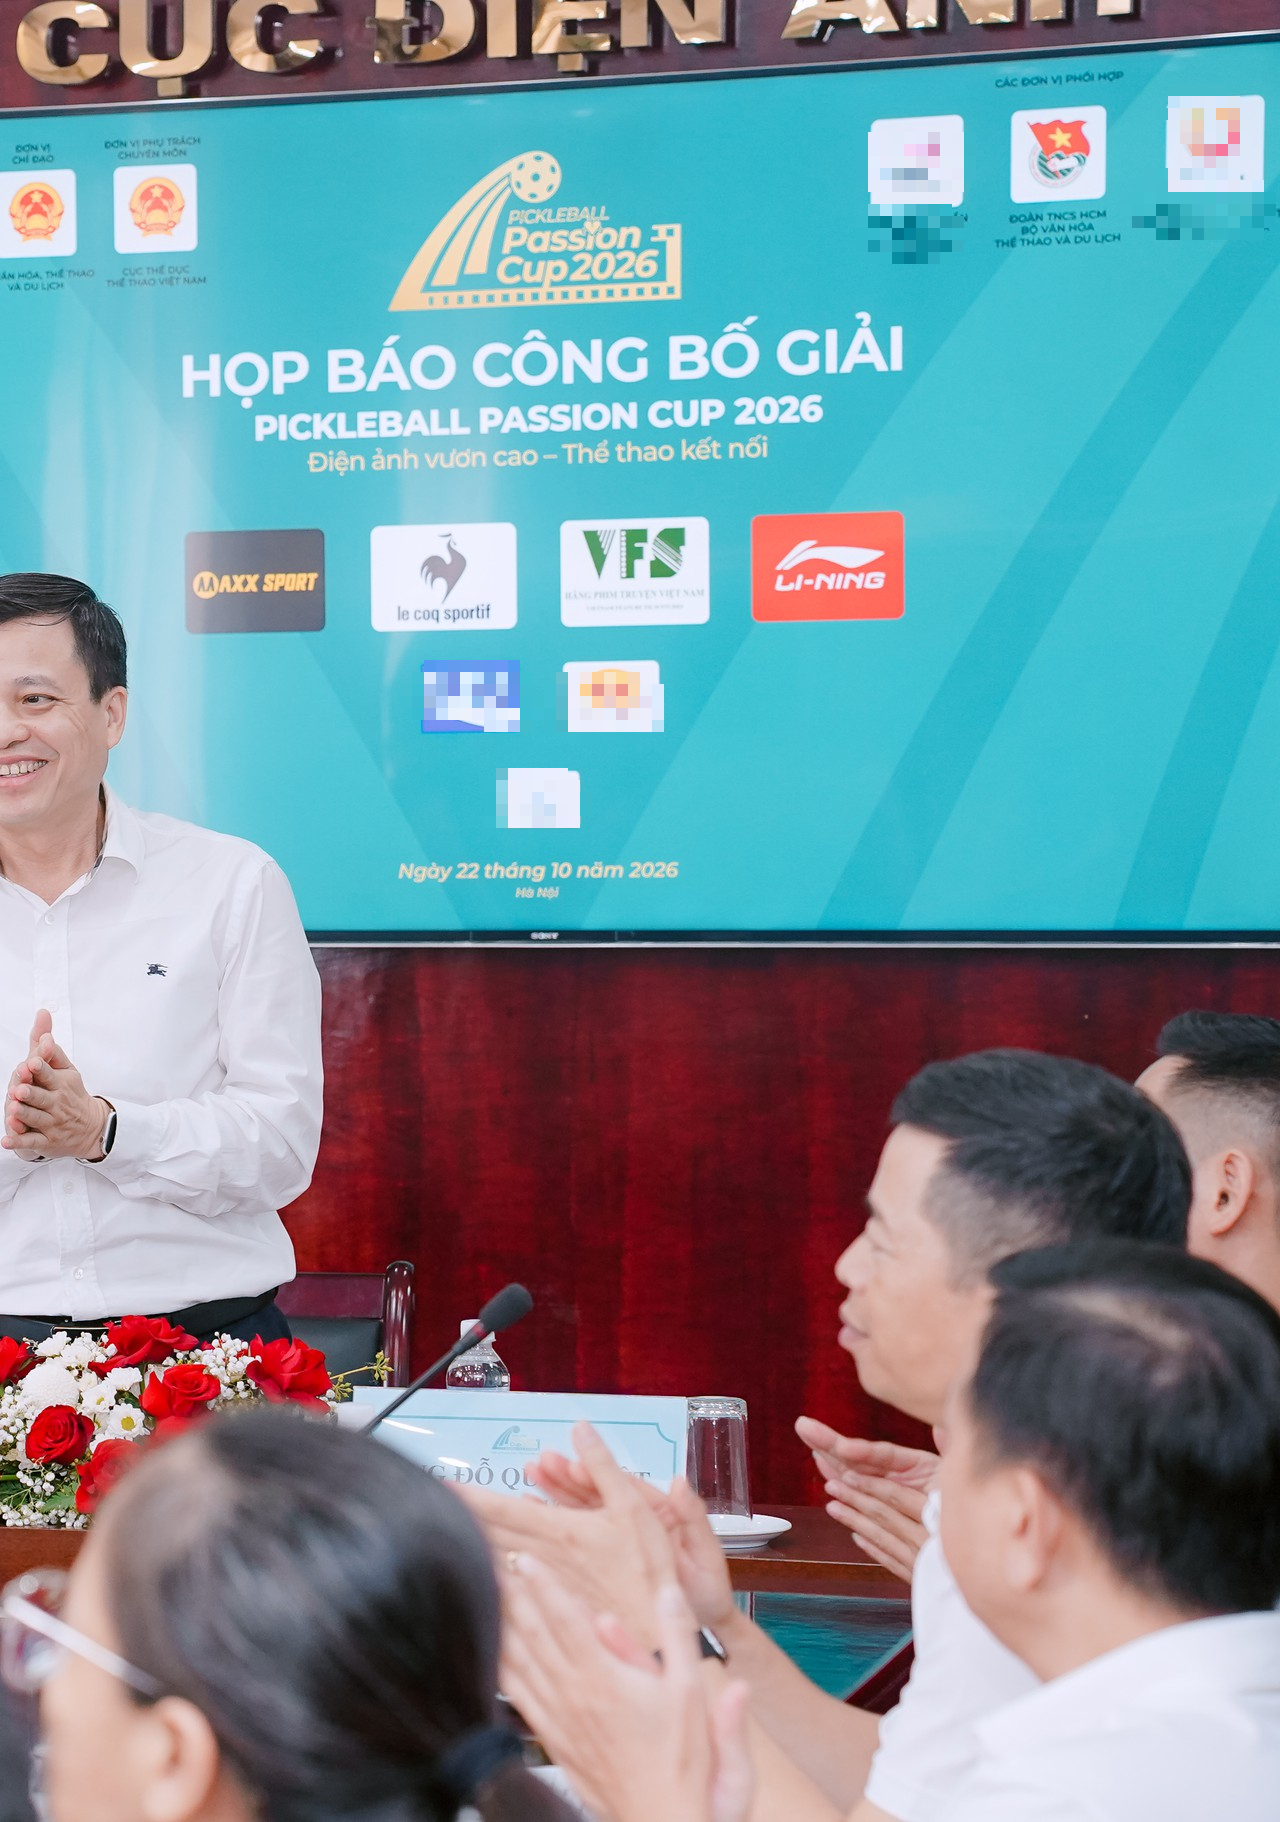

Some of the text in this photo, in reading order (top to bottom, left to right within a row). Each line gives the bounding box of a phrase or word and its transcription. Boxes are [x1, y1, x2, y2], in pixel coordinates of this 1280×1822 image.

[995, 70, 1124, 88] CÁC ĐƠN VỊ PHỐI HỢP
[104, 139, 127, 149] ĐƠN
[508, 205, 610, 225] PICKLEBALL
[1009, 210, 1107, 223] ĐOÀN TNCS HCM
[1021, 224, 1038, 235] BỘ
[1041, 223, 1065, 233] VĂN
[501, 224, 642, 255] Passion
[1020, 237, 1052, 246] THAO
[1055, 234, 1071, 244] VÀ
[1074, 235, 1091, 244] DU
[1095, 233, 1121, 244] LỊCH
[496, 249, 660, 289] Cup 2026
[24, 282, 39, 291] DU
[183, 276, 207, 285] NAM
[182, 311, 904, 409] HỌP BÁO CÔNG BỐ GIẢI
[254, 394, 824, 442] PICKLEBALL PASSION CUP 2026
[307, 450, 365, 476] Điện
[371, 447, 419, 471] ảnh
[424, 448, 486, 470] vươn
[493, 449, 539, 467] cao
[562, 439, 610, 465] Thể
[615, 440, 675, 463] thao
[681, 436, 722, 461] kết
[728, 434, 769, 459] nối
[582, 527, 686, 580] VFS
[262, 572, 319, 592] SPORT
[774, 571, 886, 592] LI-NING
[397, 603, 491, 623] le coq sportif
[398, 861, 679, 883] Ngày 22 tháng 10 năm 2026
[453, 1457, 494, 1486] ĐỖ
